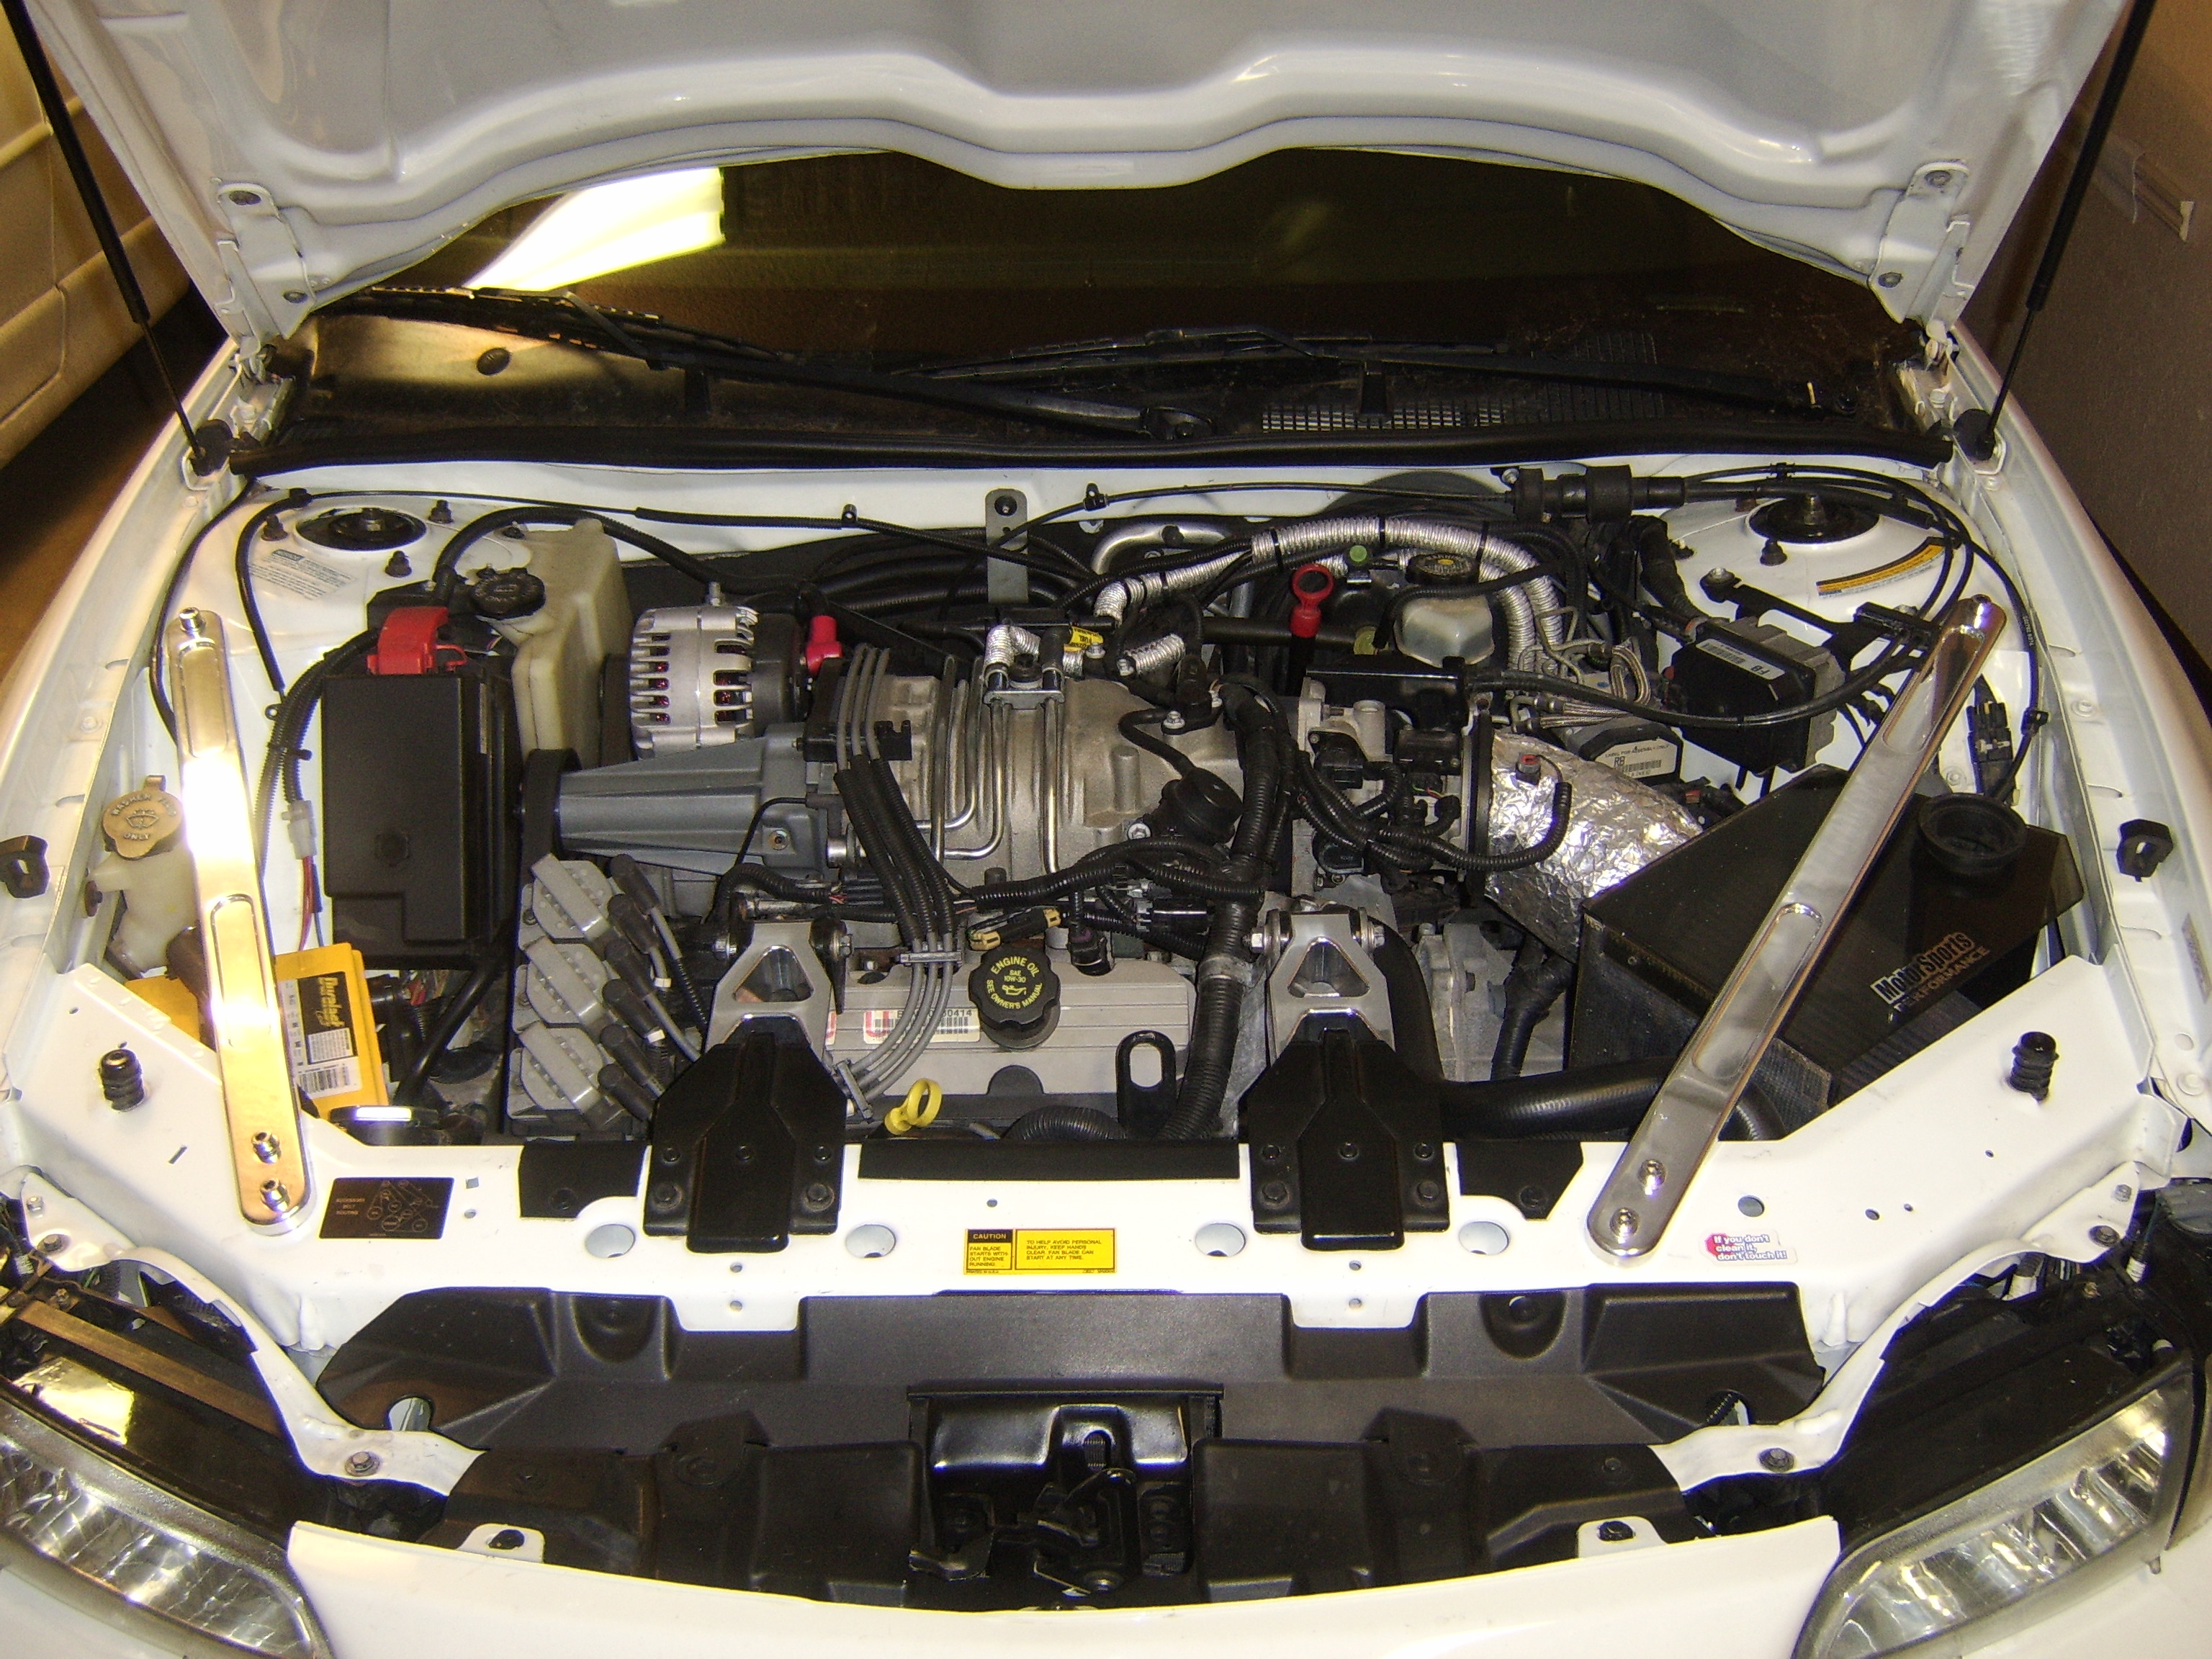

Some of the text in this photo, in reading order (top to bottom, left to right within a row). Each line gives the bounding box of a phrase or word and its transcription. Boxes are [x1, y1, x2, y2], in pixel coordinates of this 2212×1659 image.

[991, 956, 1040, 977] ENGINE OIL
[986, 979, 1043, 1009] SEE OWNER'S MANUAL
[1714, 1234, 1770, 1244] If you don't
[1717, 1252, 1744, 1261] don't
[1745, 1251, 1775, 1260] touch
